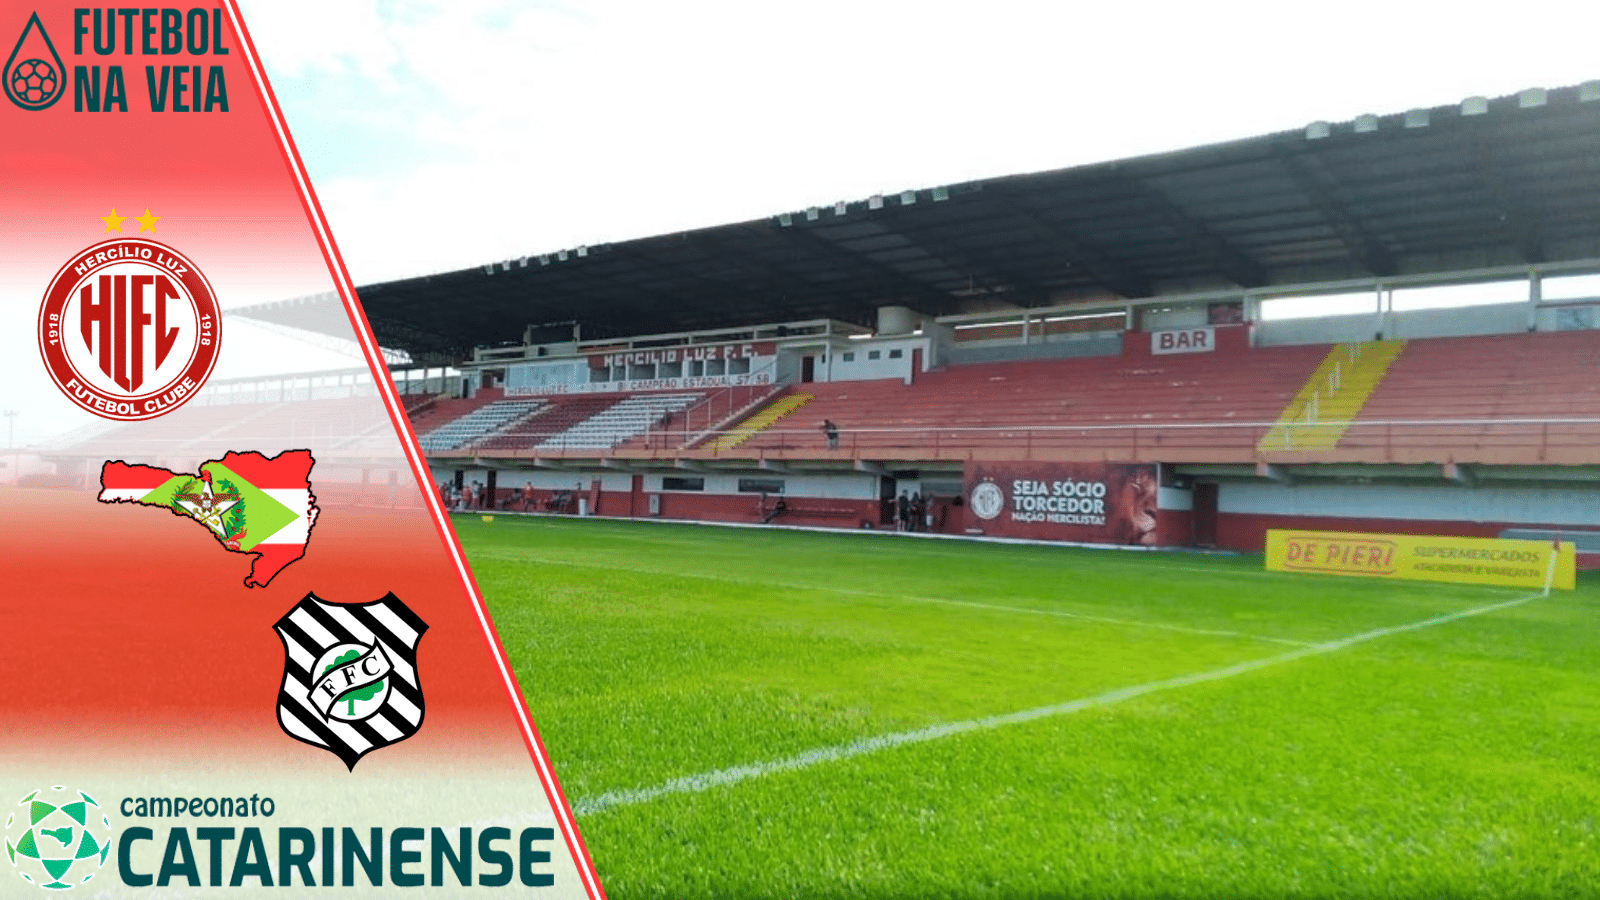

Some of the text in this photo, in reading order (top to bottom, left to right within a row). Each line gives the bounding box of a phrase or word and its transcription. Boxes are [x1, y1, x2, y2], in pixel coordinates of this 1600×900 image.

[1160, 331, 1207, 349] BAR
[684, 347, 716, 361] LUZ
[1013, 477, 1106, 498] SEJA SÓCIO
[1012, 496, 1104, 514] TORCEDOR
[1011, 511, 1045, 523] NAÇÃO
[1287, 542, 1394, 568] DE PIERI
[1413, 546, 1540, 563] SUPERMERCADOS
